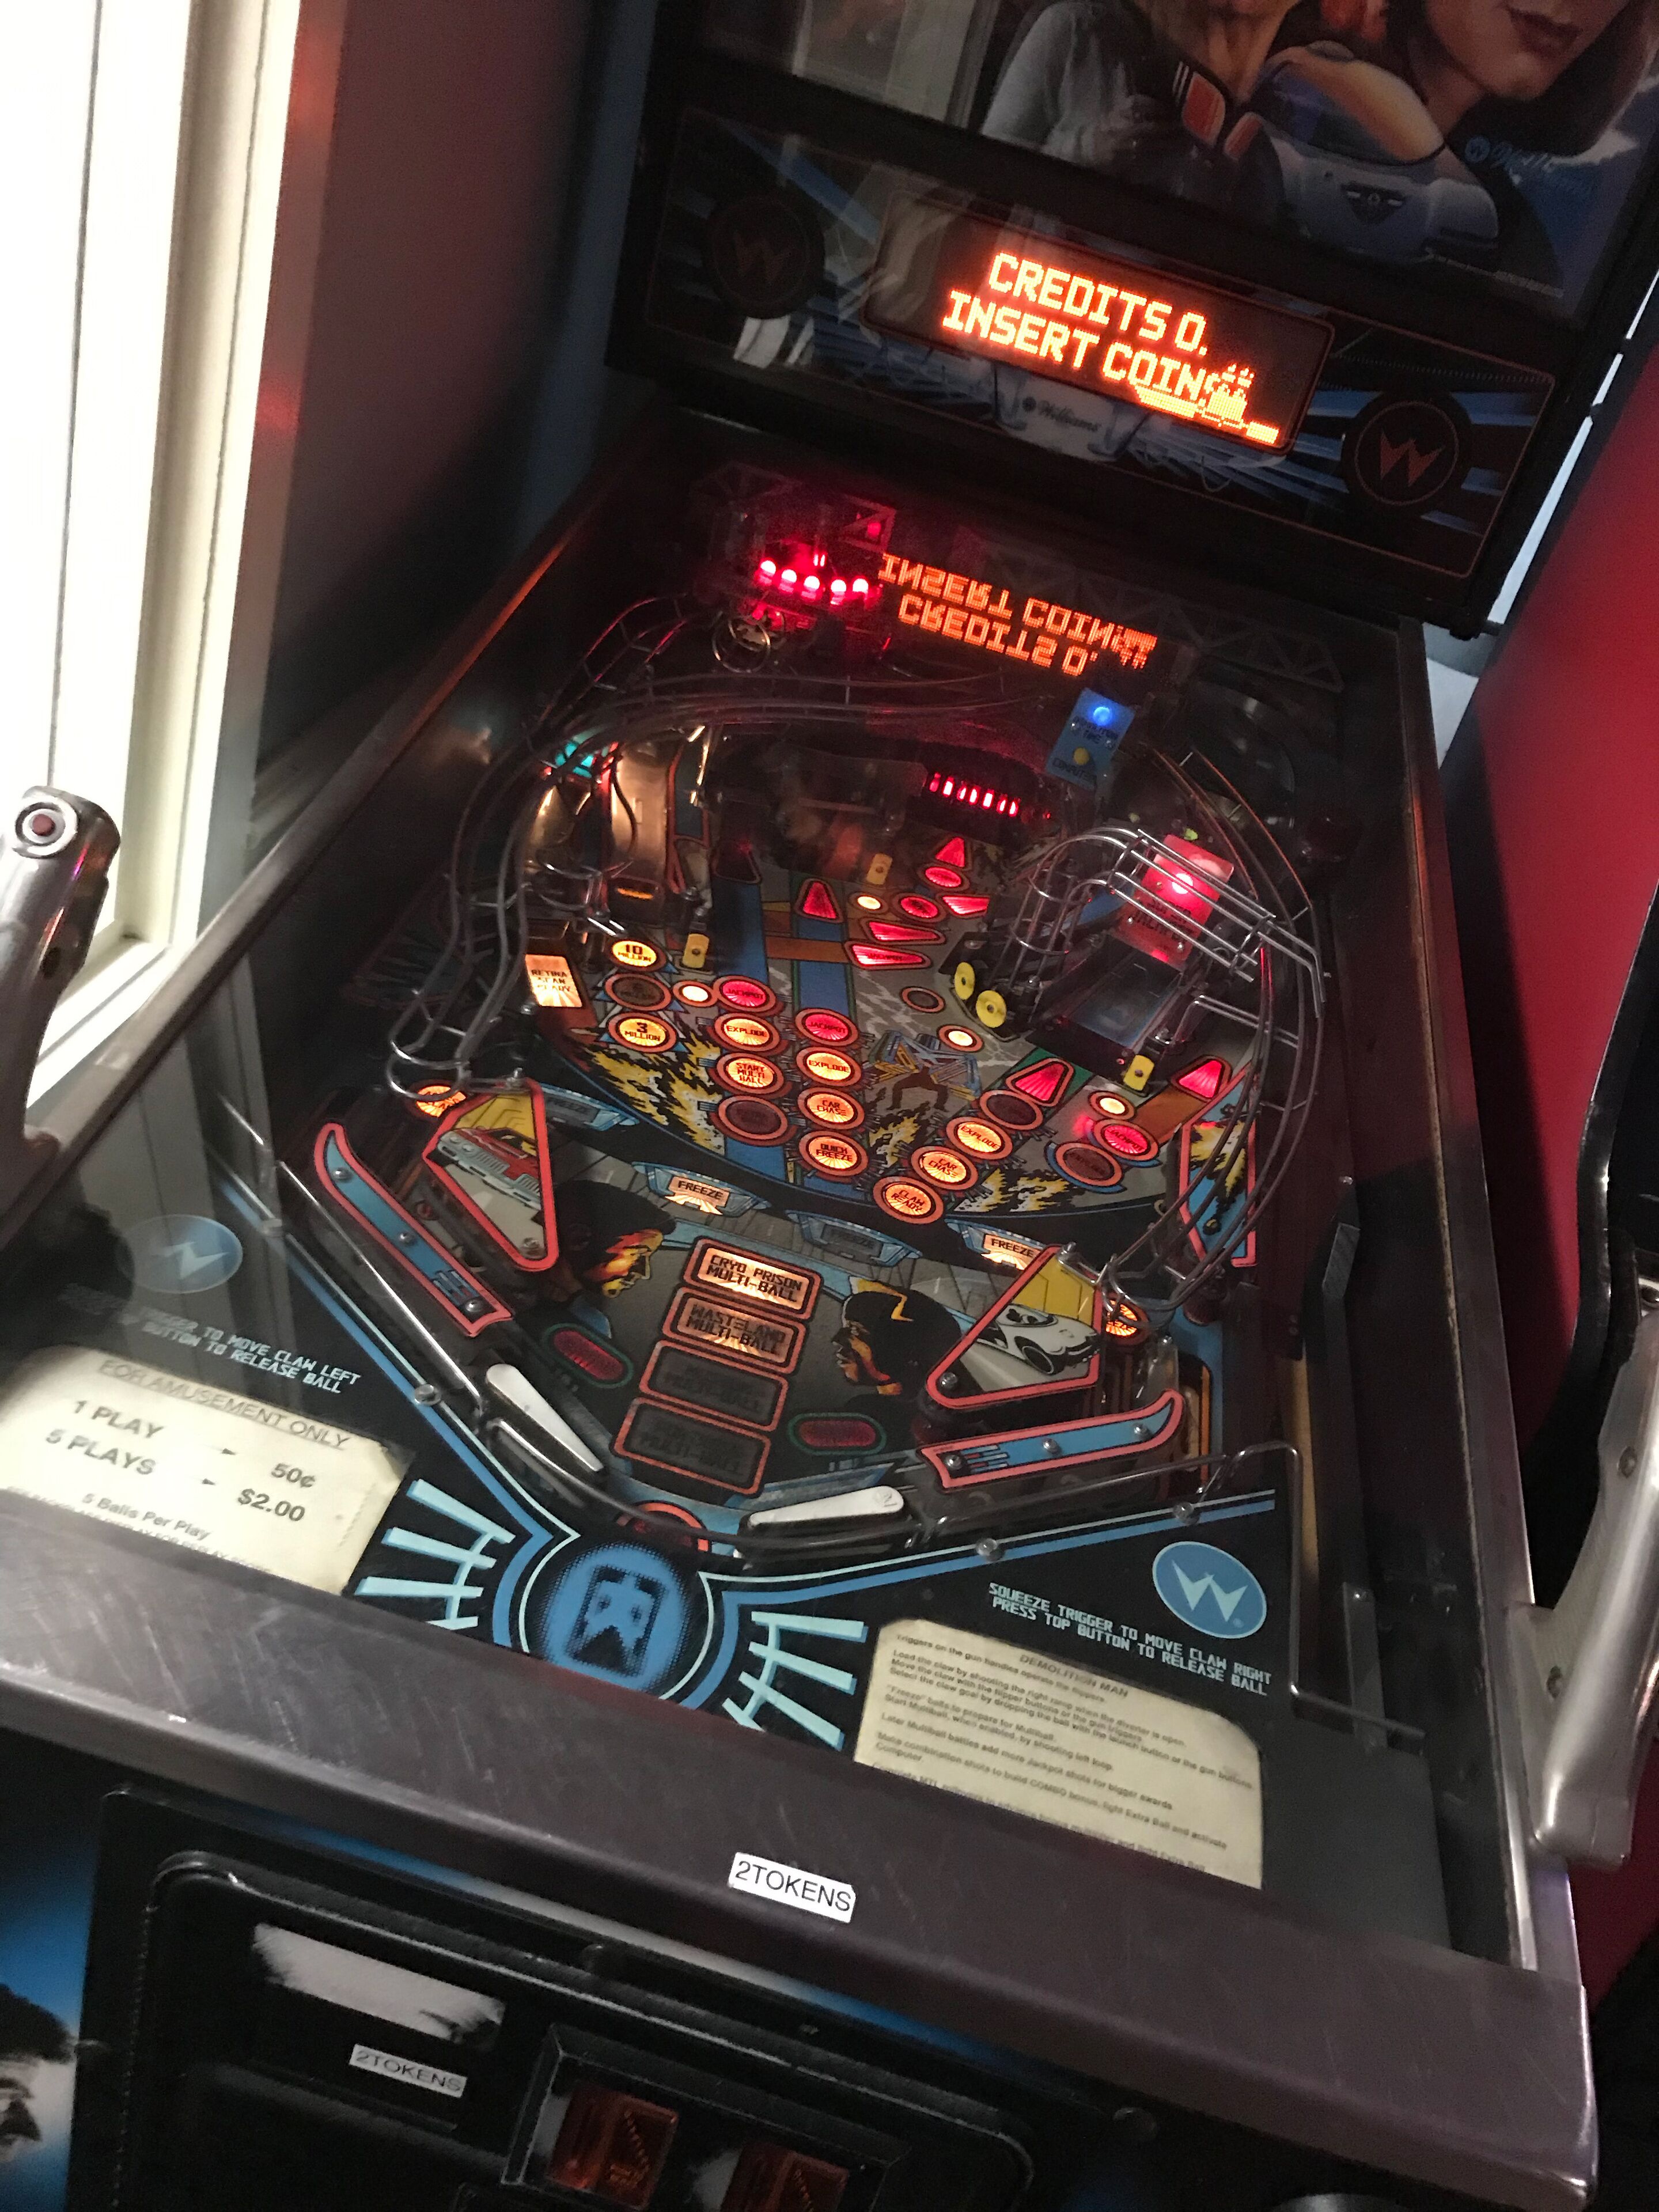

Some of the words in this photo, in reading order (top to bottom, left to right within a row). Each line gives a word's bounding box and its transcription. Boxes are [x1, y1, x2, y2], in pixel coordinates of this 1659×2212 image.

[988, 252, 1172, 341] CREDITS
[943, 290, 1100, 370] INSERT
[618, 951, 652, 962] MILLION
[626, 944, 643, 955] 10
[531, 969, 567, 978] RETINA
[624, 1031, 661, 1041] MILLION
[637, 1022, 648, 1033] 3
[726, 1025, 767, 1037] EXPLODE
[736, 1062, 765, 1073] START
[737, 1069, 765, 1079] MULTI
[808, 1059, 851, 1073] EXPLODE
[739, 1075, 764, 1085] BALL
[816, 1105, 847, 1116] CHASE
[821, 1099, 840, 1109] CAR
[820, 1142, 848, 1154] QUICK
[961, 1125, 1000, 1150] EXPLODE
[1109, 1128, 1146, 1152] JACKPOT
[816, 1149, 853, 1162] FREEZE
[938, 1158, 957, 1171] CAR
[928, 1160, 958, 1179] CHASE
[677, 1180, 724, 1200] FREEZE
[898, 1189, 925, 1206] CLAW
[891, 1192, 923, 1212] READY
[991, 1238, 1035, 1258] FREEZE
[706, 1264, 798, 1302] MULTI-BALL
[710, 1254, 747, 1274] CRYO
[753, 1267, 803, 1291] PRISON
[684, 1316, 781, 1355] MULTI-BALL
[204, 1326, 224, 1341] TO
[226, 1334, 271, 1357] MOVE
[274, 1350, 317, 1373] CLAW
[320, 1364, 361, 1385] LEFT
[206, 1339, 228, 1355] TO
[228, 1349, 301, 1379] RELEASE
[302, 1373, 342, 1394] BALL
[99, 1360, 143, 1388] FOR
[151, 1374, 285, 1429] AMUSEMENT
[288, 1418, 350, 1450] ONLY
[74, 1399, 85, 1415] 1
[92, 1405, 165, 1440] PLAY
[270, 1462, 316, 1489] 50¢
[46, 1429, 62, 1445] 5
[67, 1434, 157, 1476] PLAYS
[237, 1488, 306, 1522] $2.00
[82, 1493, 96, 1505] 5
[97, 1498, 139, 1519] Balls
[142, 1510, 173, 1528] Per
[174, 1520, 212, 1542] Play
[988, 1581, 1050, 1613] SQUEEZE
[1057, 1604, 1113, 1634] TRIGGER
[1120, 1624, 1138, 1641] TO
[1145, 1633, 1183, 1656] MOVE
[1190, 1647, 1227, 1671] CLAW
[1234, 1662, 1272, 1685] RIGHT
[897, 1634, 933, 1648] Triggers
[935, 1643, 946, 1652] on
[949, 1647, 963, 1656] the
[965, 1652, 982, 1662] gun
[992, 1596, 1037, 1621] PRESS
[1044, 1612, 1071, 1631] TOP
[1077, 1623, 1131, 1652] BUTTON
[1137, 1643, 1155, 1660] TO
[1161, 1650, 1225, 1683] RELEASE
[1231, 1676, 1268, 1696] BALL
[892, 1658, 915, 1670] Move
[918, 1665, 932, 1675] the
[934, 1670, 955, 1682] claw
[957, 1676, 976, 1688] with
[978, 1683, 992, 1693] the
[893, 1649, 916, 1661] Load
[918, 1655, 932, 1665] the
[934, 1660, 955, 1672] claw
[956, 1667, 968, 1677] by
[1011, 1684, 1025, 1694] the
[1020, 1654, 1096, 1687] DEMOLITION
[1099, 1682, 1129, 1698] MAN
[889, 1667, 917, 1680] Select
[919, 1675, 934, 1685] the
[935, 1680, 957, 1692] claw
[980, 1694, 993, 1705] by
[994, 1698, 1035, 1718] dropping
[1036, 1710, 1051, 1721] the
[952, 1703, 962, 1713] to
[885, 1694, 907, 1707] Start
[1020, 1736, 1031, 1746] by
[981, 1743, 999, 1755] add
[877, 1730, 903, 1746] Make
[992, 1767, 1002, 1777] to
[1126, 1808, 1150, 1824] Extra
